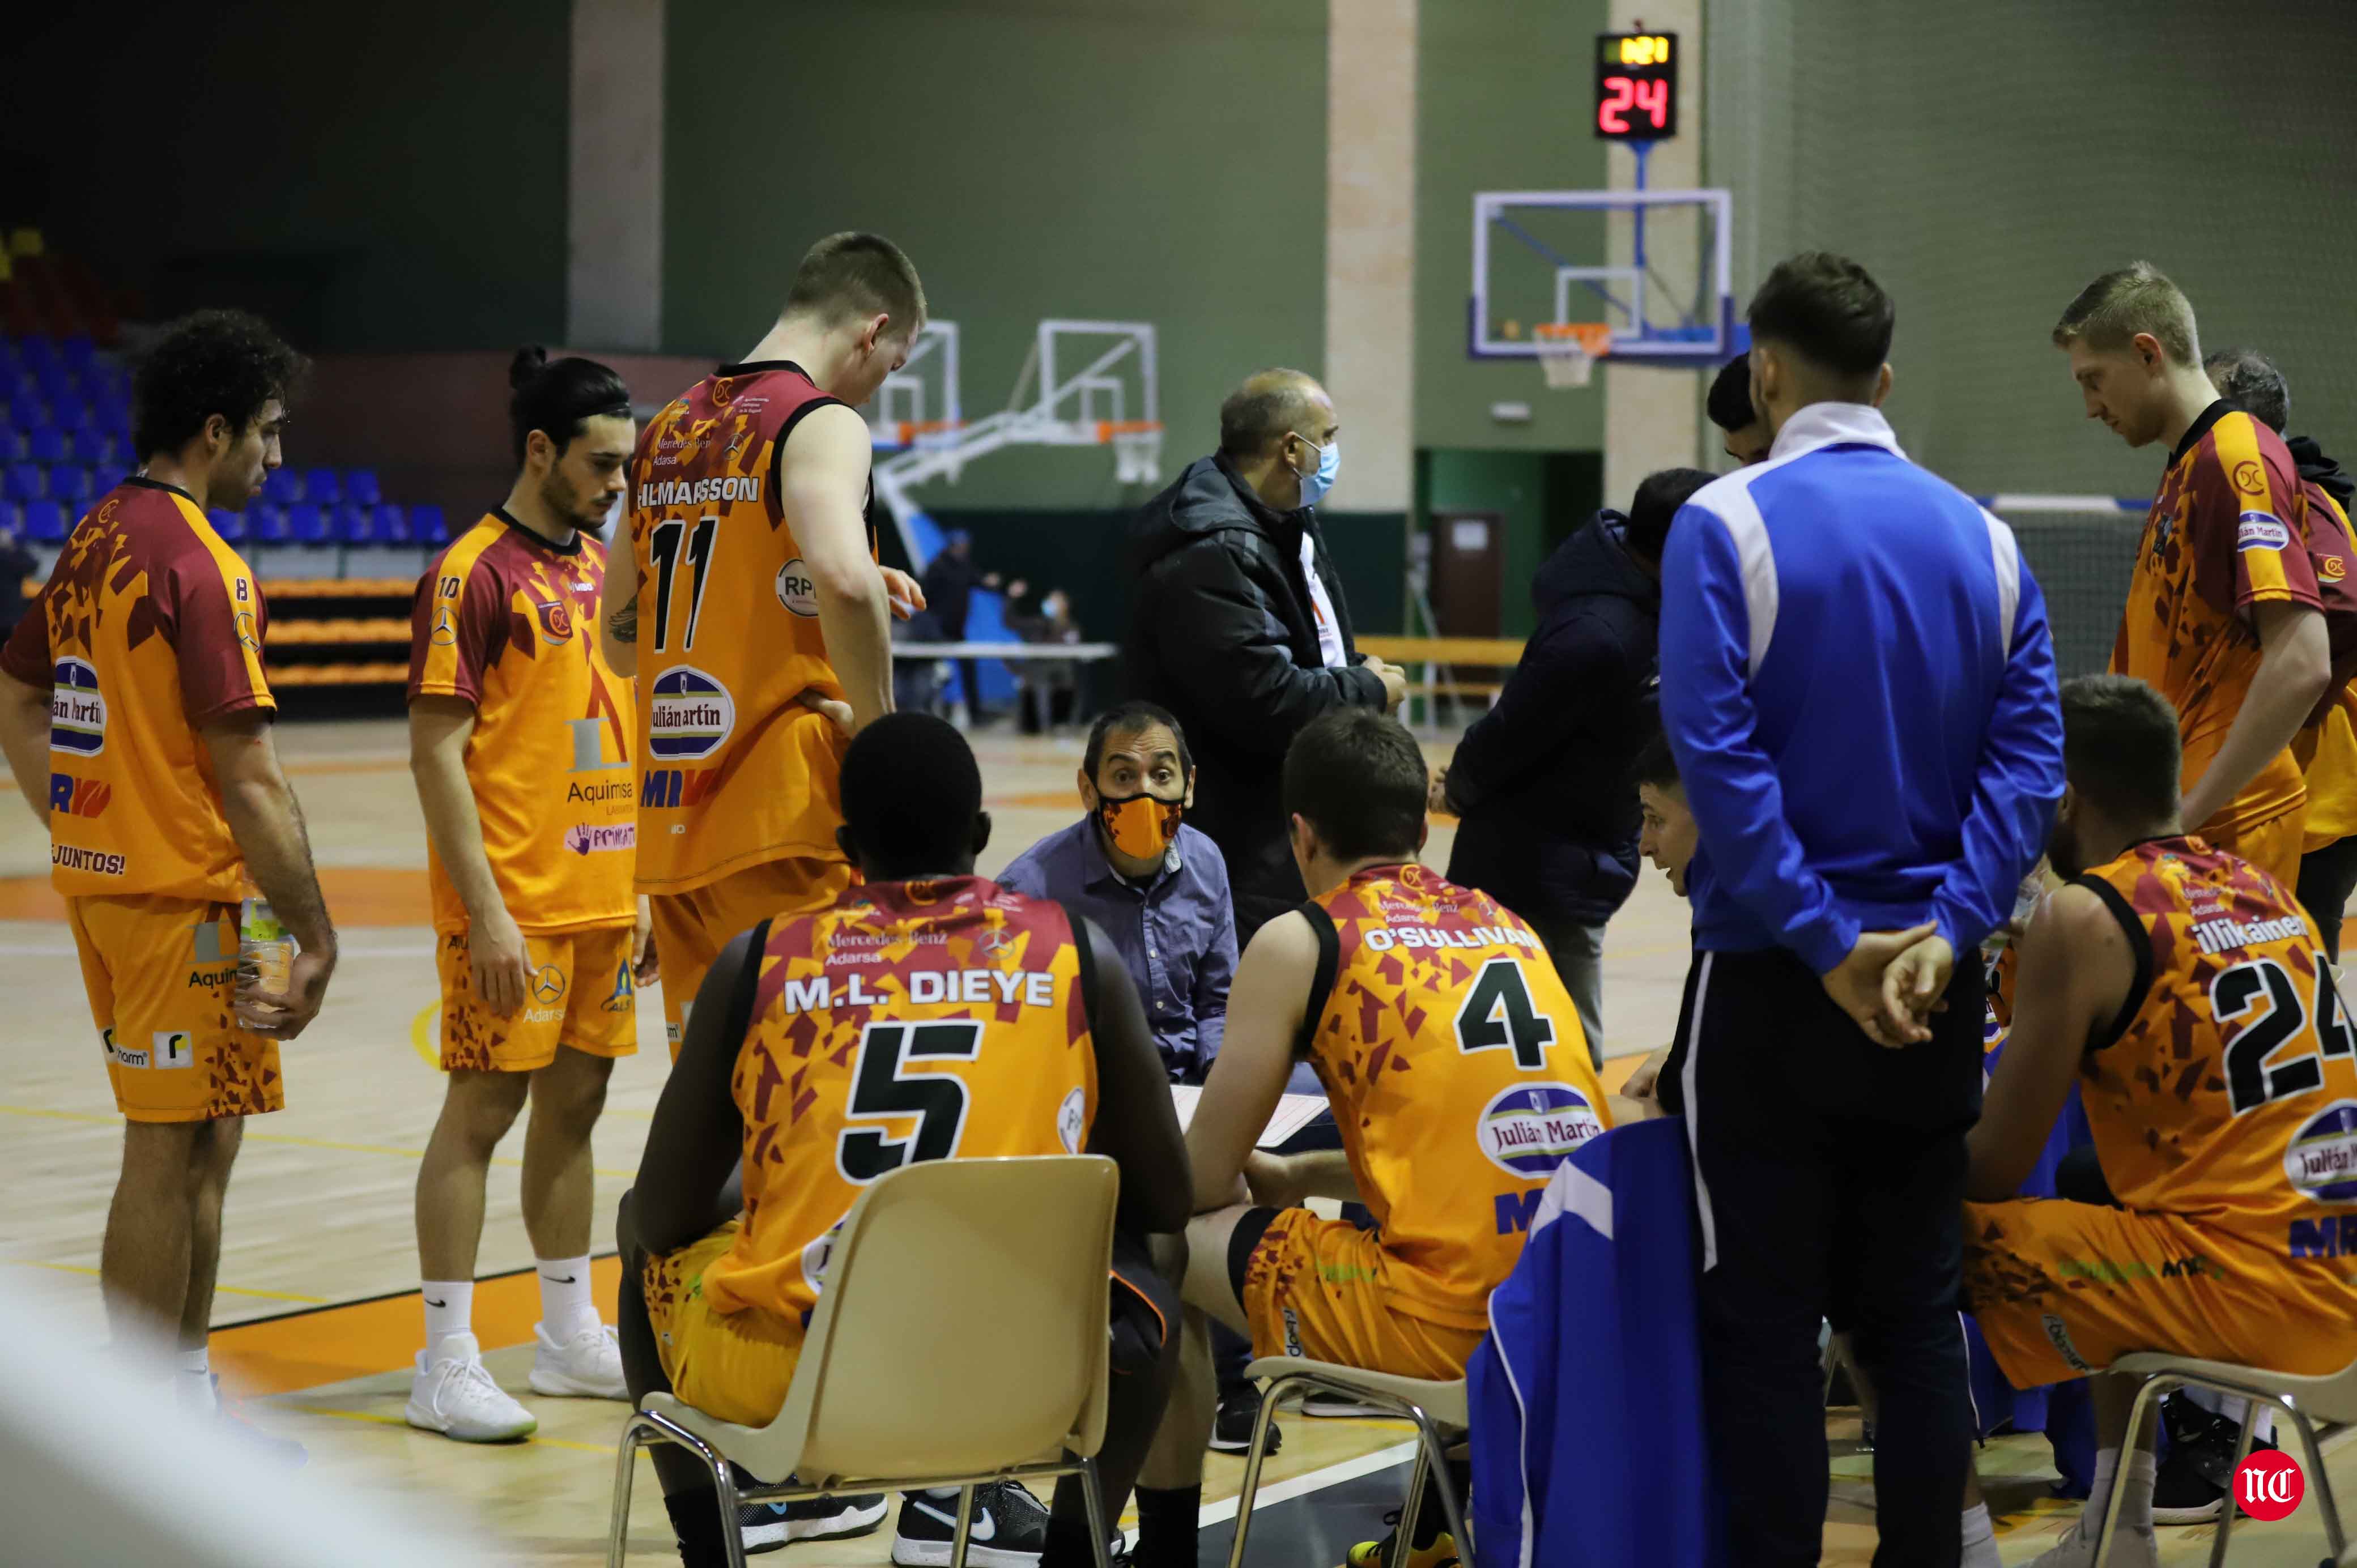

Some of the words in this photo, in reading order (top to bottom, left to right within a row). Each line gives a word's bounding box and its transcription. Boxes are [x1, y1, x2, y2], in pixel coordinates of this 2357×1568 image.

[1599, 76, 1667, 133] 24
[653, 455, 676, 466] Adarsa
[236, 577, 249, 602] 8
[439, 576, 461, 599] 10
[650, 516, 719, 653] 11
[785, 576, 816, 599] RP
[651, 705, 681, 728] ulián
[683, 704, 721, 726] artín
[1364, 926, 1542, 952] O'SULLIVAN
[825, 952, 882, 966] Adarsa
[785, 973, 888, 1014] M.L.
[909, 969, 1054, 1007] DIEYE
[522, 1008, 564, 1024] Adars
[1453, 957, 1558, 1071] 4
[835, 1018, 985, 1186] 5
